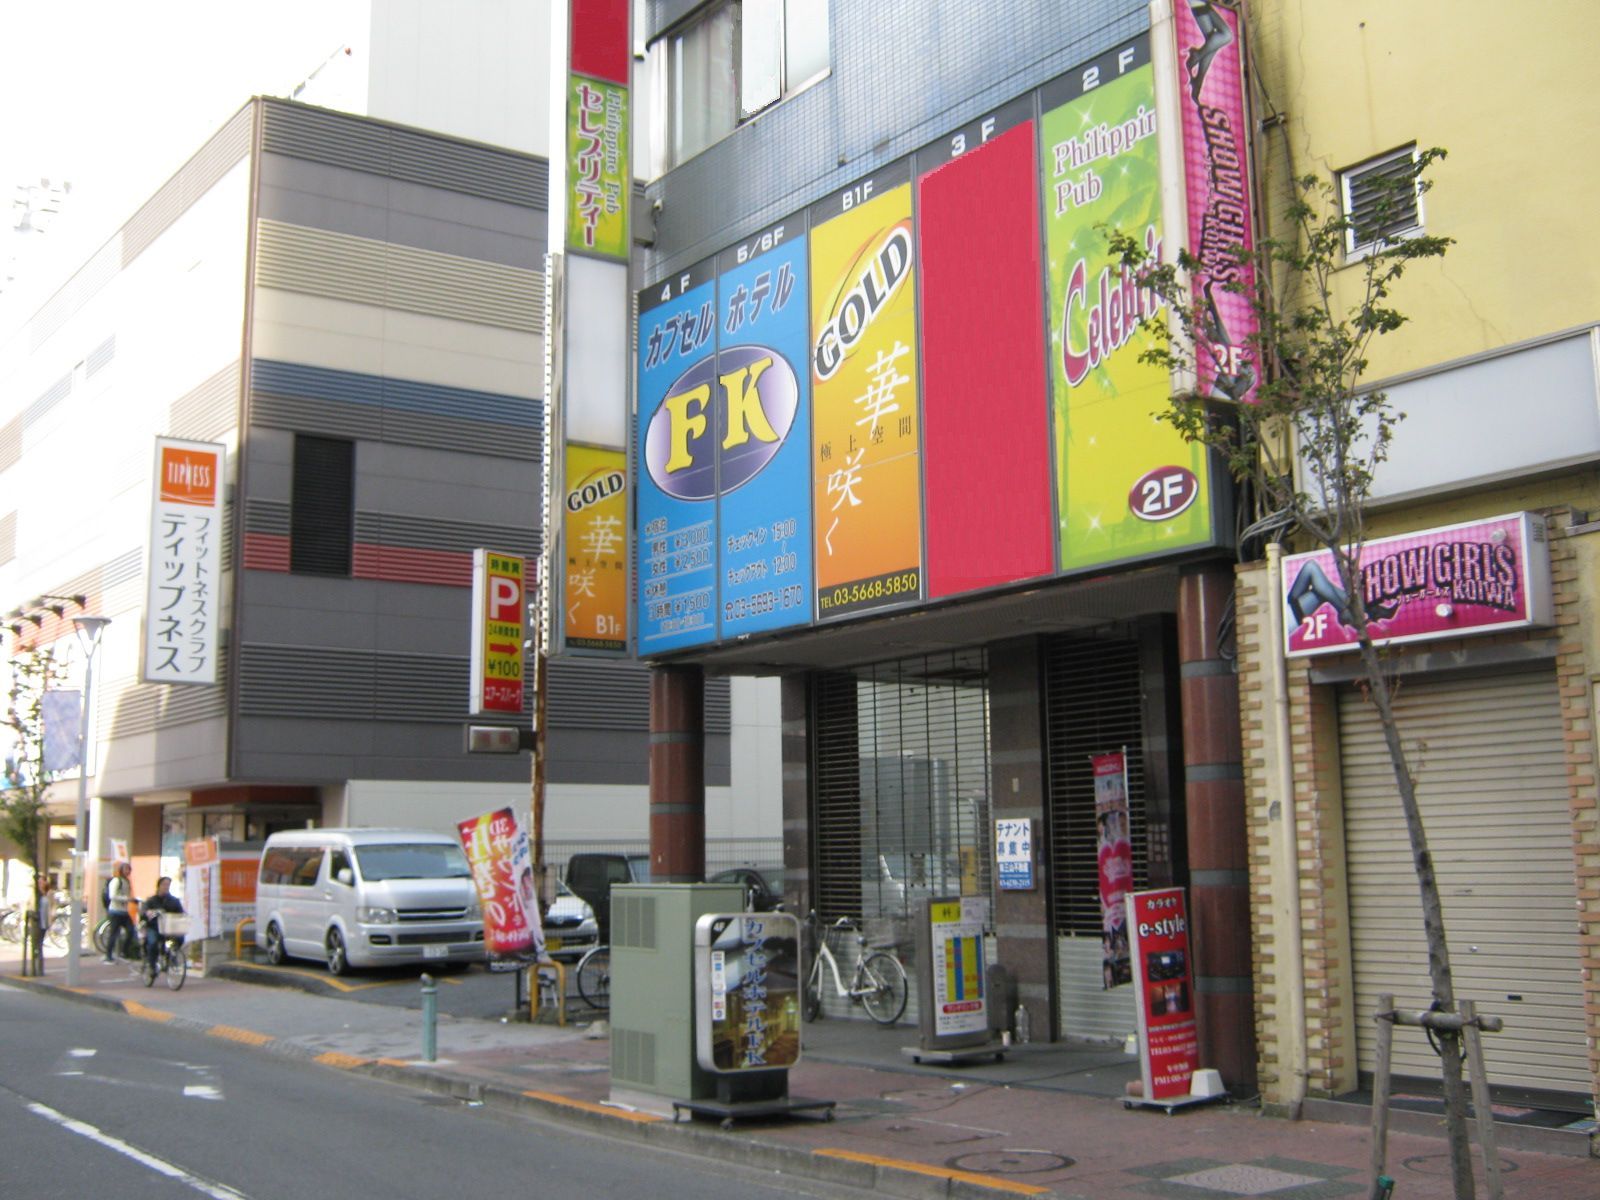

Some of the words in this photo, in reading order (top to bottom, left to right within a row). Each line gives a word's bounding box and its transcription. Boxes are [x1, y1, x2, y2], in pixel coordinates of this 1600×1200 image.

[605, 89, 622, 174] Philippine
[605, 181, 620, 215] Pub
[842, 179, 875, 212] B1F
[1055, 168, 1102, 217] Pub
[737, 226, 785, 264] 5/6F
[725, 262, 796, 334] ホテル
[815, 225, 914, 381] GOLD
[1214, 344, 1242, 375] 2F
[820, 415, 912, 463] 極上空間
[567, 472, 625, 513] GOLD
[1140, 473, 1186, 514] 2F
[771, 519, 797, 541] 15:00
[773, 552, 797, 576] 12:00
[156, 513, 188, 673] ティップネス
[189, 515, 211, 674] フィットネスクラブ
[489, 576, 520, 619] P
[596, 614, 621, 635] B1F
[1303, 613, 1328, 641] 2F
[488, 659, 520, 678] ¥100
[997, 822, 1029, 838] テナント
[1139, 913, 1185, 940] e-style
